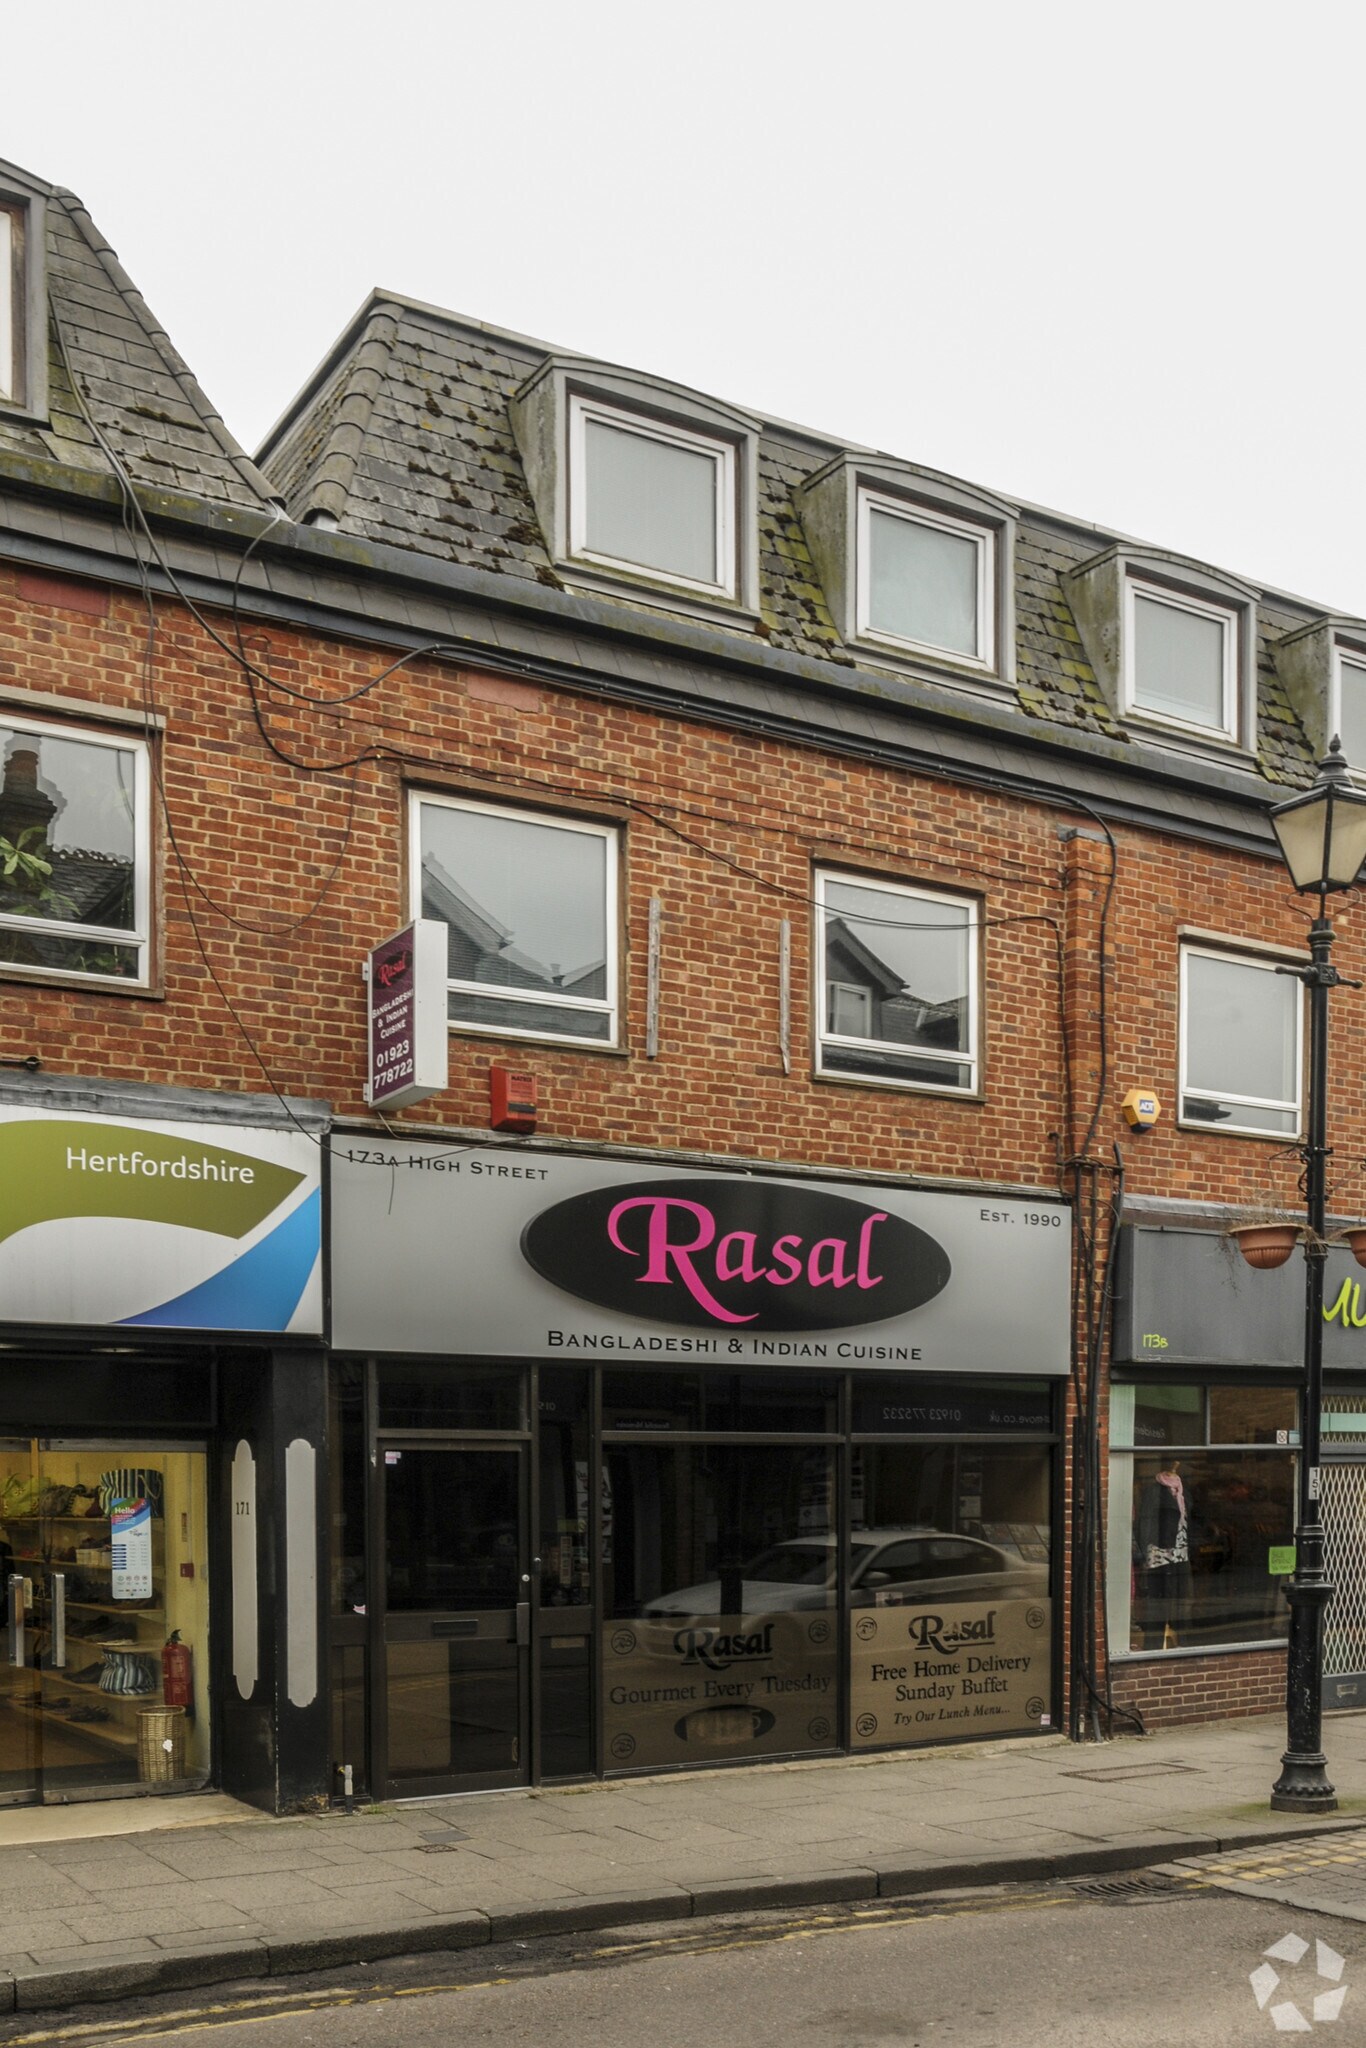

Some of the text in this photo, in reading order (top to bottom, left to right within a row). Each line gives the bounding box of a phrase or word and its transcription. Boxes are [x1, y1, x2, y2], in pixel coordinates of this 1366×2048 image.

[377, 1005, 408, 1028] & INDIAN
[380, 1019, 406, 1039] CUISINE
[376, 1039, 409, 1067] 01923
[374, 1058, 413, 1089] 778722
[66, 1146, 255, 1184] Hertfordshire
[347, 1149, 549, 1180] 173A HIGH STREET
[980, 1209, 1061, 1228] EST. 1990
[607, 1196, 888, 1324] Rasal
[547, 1330, 922, 1361] BANGLADESHI & INDIAN CUISINE
[114, 1506, 136, 1514] Hello
[235, 1501, 250, 1515] 171
[907, 1610, 997, 1655] Rasal
[673, 1623, 775, 1671] Rasal
[871, 1655, 1031, 1681] Free Home Delivery
[609, 1673, 831, 1705] Gourmet Every Tuesday
[895, 1676, 1009, 1701] Sunday Buffet
[894, 1712, 912, 1726] Try
[915, 1709, 935, 1722] Our
[938, 1707, 970, 1720] Lunch
